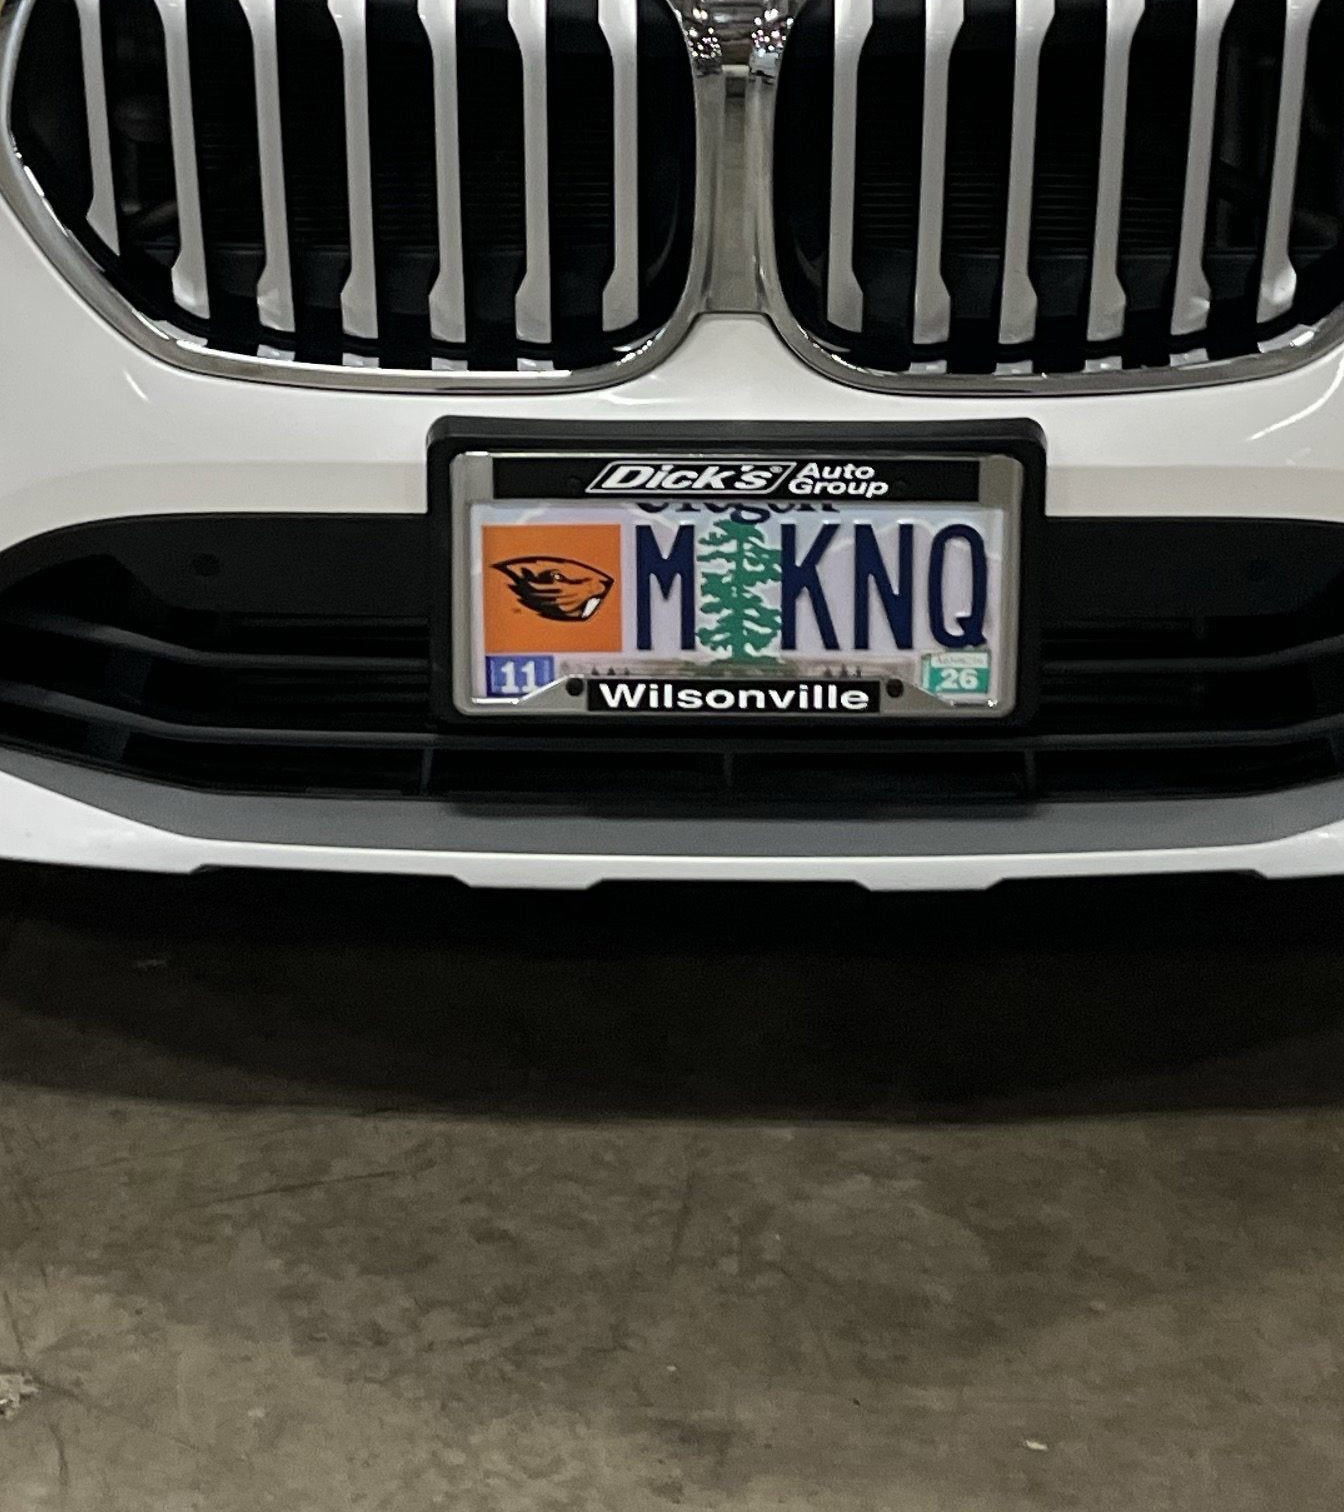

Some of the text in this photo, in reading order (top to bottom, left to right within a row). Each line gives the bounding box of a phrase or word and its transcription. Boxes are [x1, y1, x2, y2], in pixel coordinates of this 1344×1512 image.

[796, 462, 875, 480] Auto
[788, 478, 889, 499] Group
[501, 660, 543, 694] 11
[940, 668, 978, 689] 26
[599, 683, 869, 710] Wilsonville
